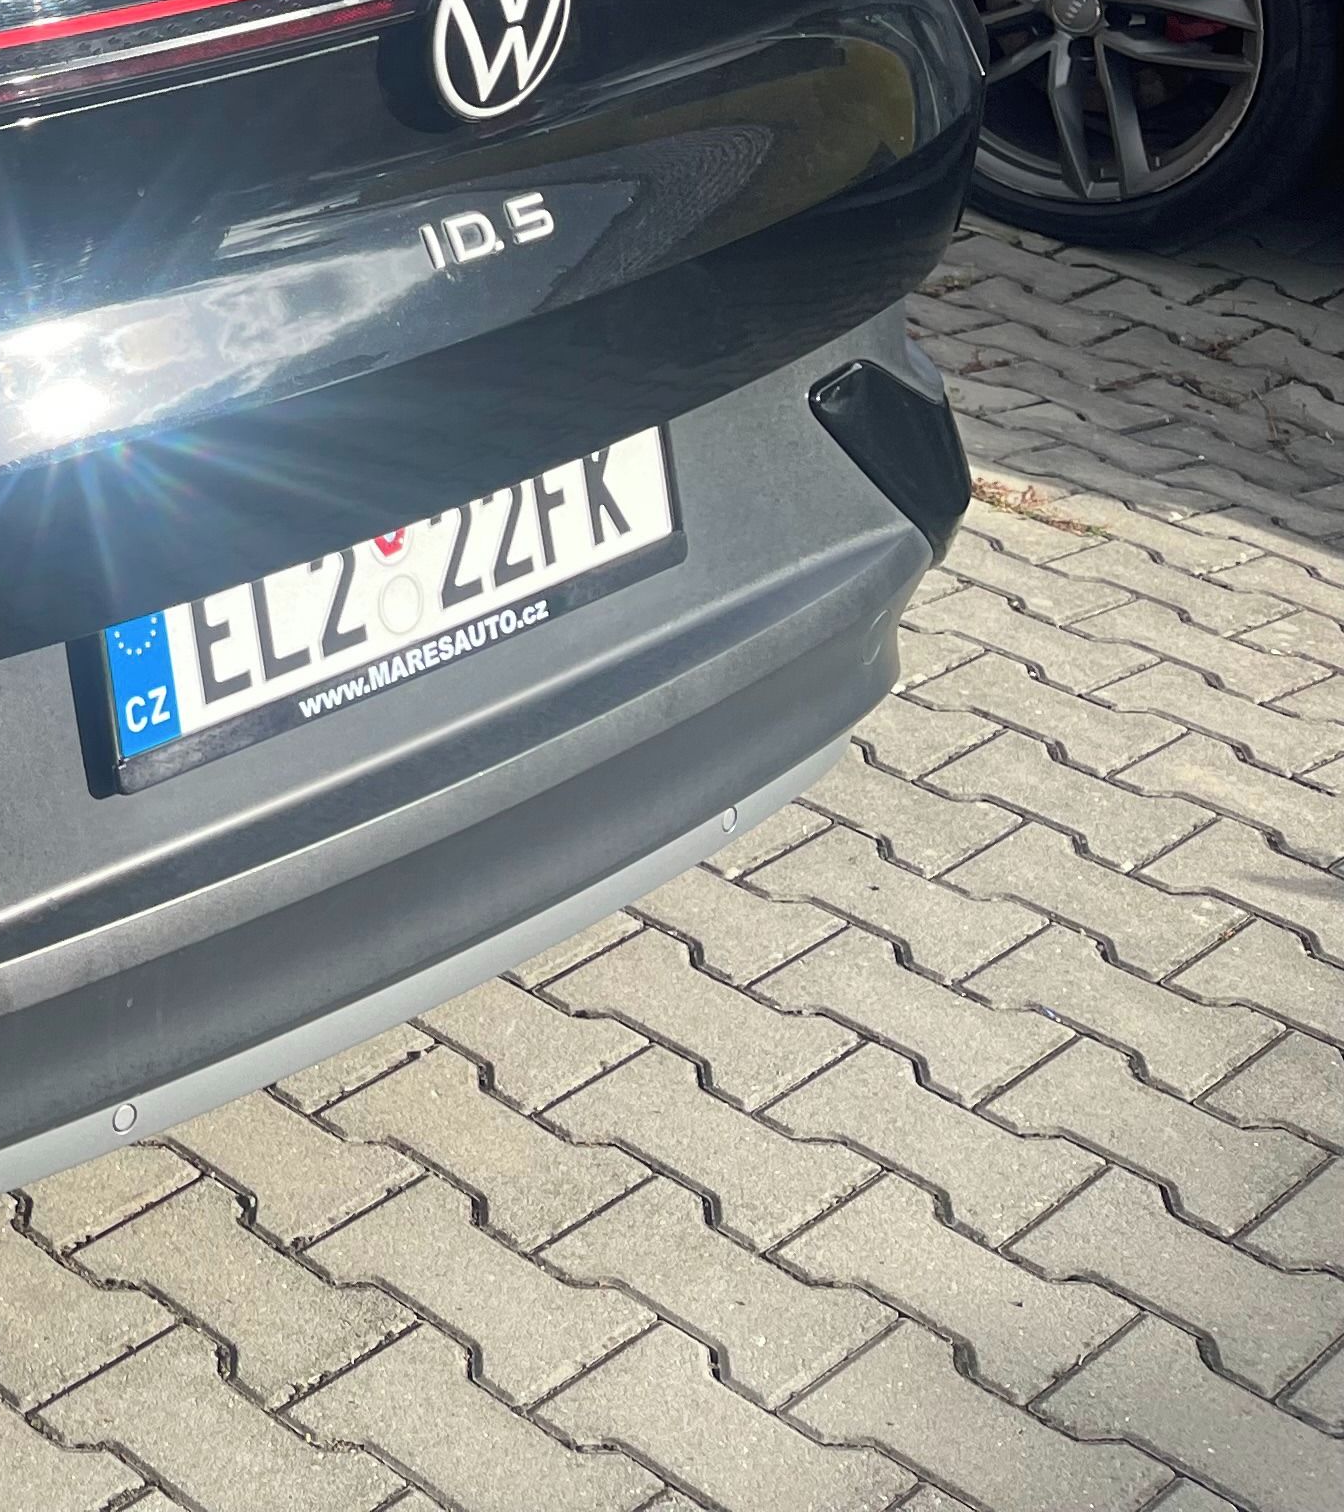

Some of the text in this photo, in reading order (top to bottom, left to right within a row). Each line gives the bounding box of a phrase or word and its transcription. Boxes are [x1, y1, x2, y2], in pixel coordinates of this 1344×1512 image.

[190, 445, 631, 705] EL2 22FK
[125, 685, 171, 733] CZ
[298, 599, 550, 718] www.MARESAUTO.cz
